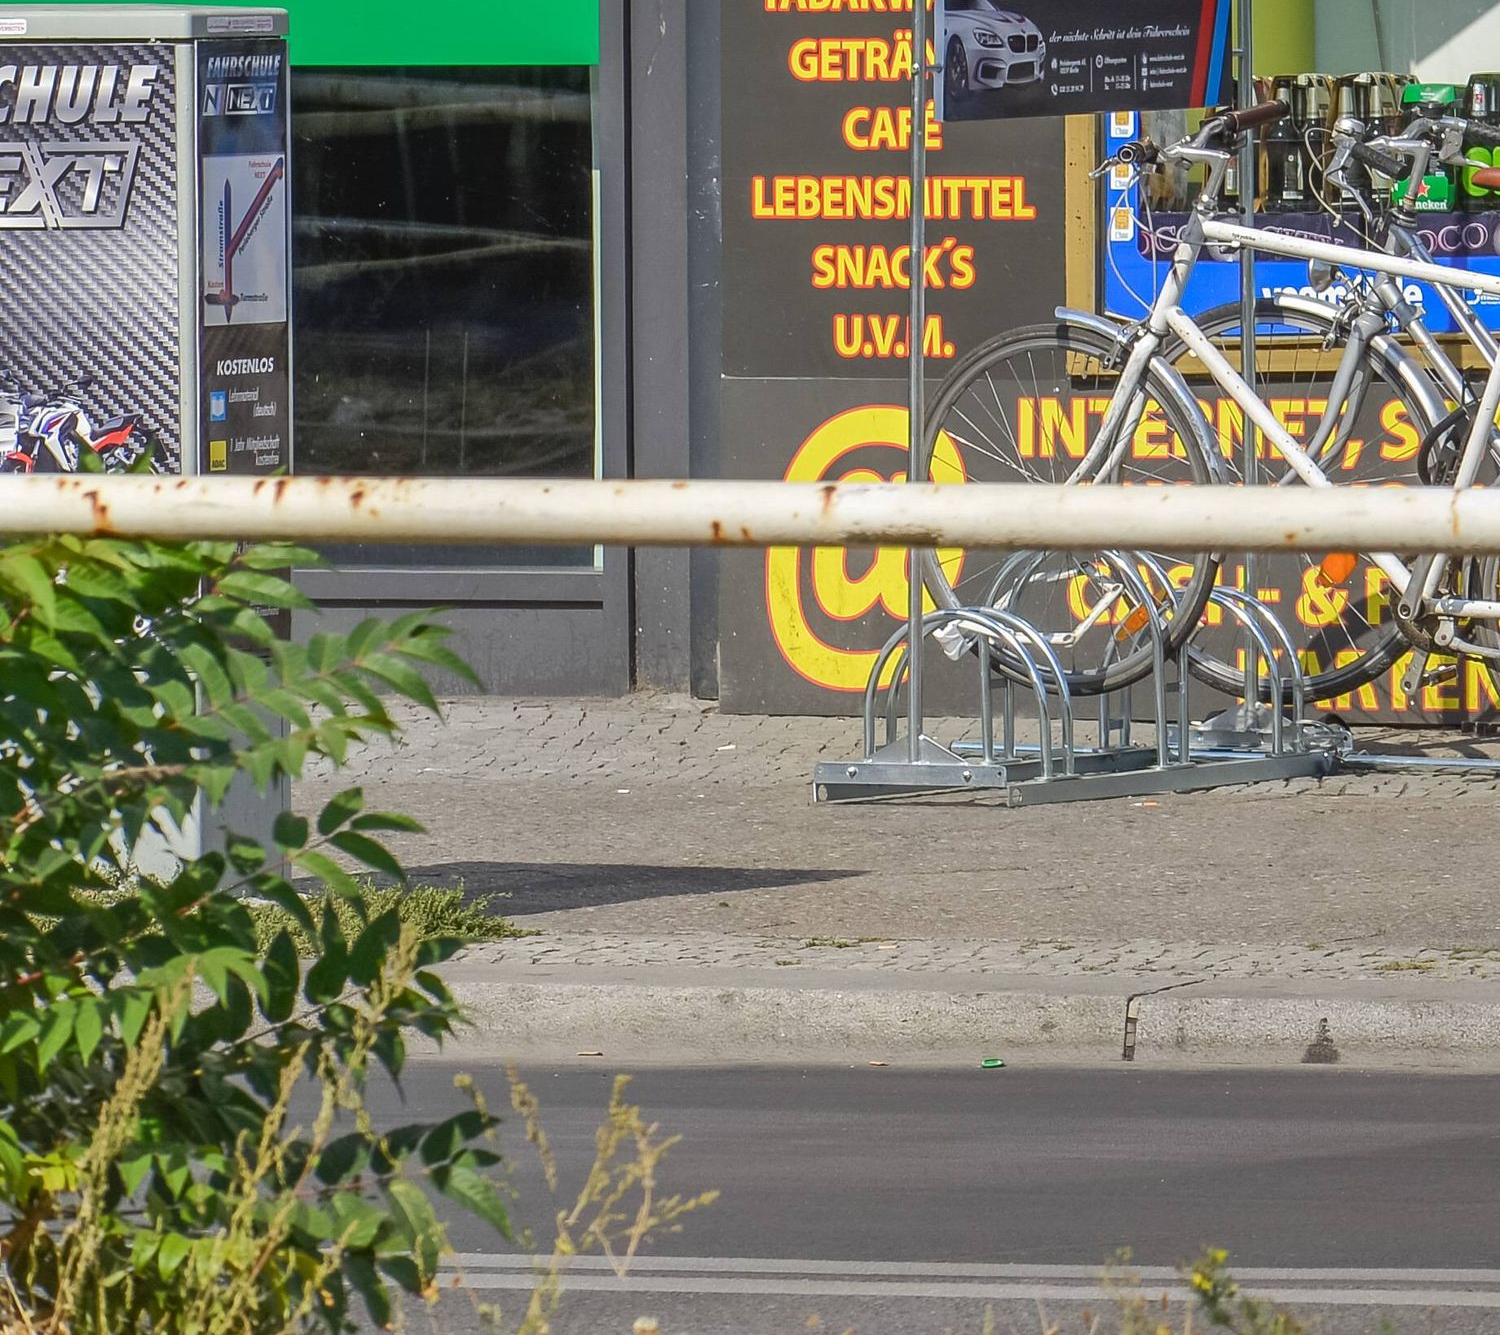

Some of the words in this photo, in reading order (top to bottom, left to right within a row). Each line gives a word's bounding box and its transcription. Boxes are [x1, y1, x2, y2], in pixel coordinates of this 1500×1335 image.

[1049, 30, 1062, 43] der
[206, 54, 281, 78] FAHRSCHULE
[789, 30, 937, 82] GETRÄ
[227, 85, 275, 113] NEXT
[843, 102, 943, 151] CAFÉ
[752, 177, 1037, 221] LEBENSMITTEL
[834, 315, 956, 360] U.V.M.
[216, 357, 275, 376] KOSTENLOS
